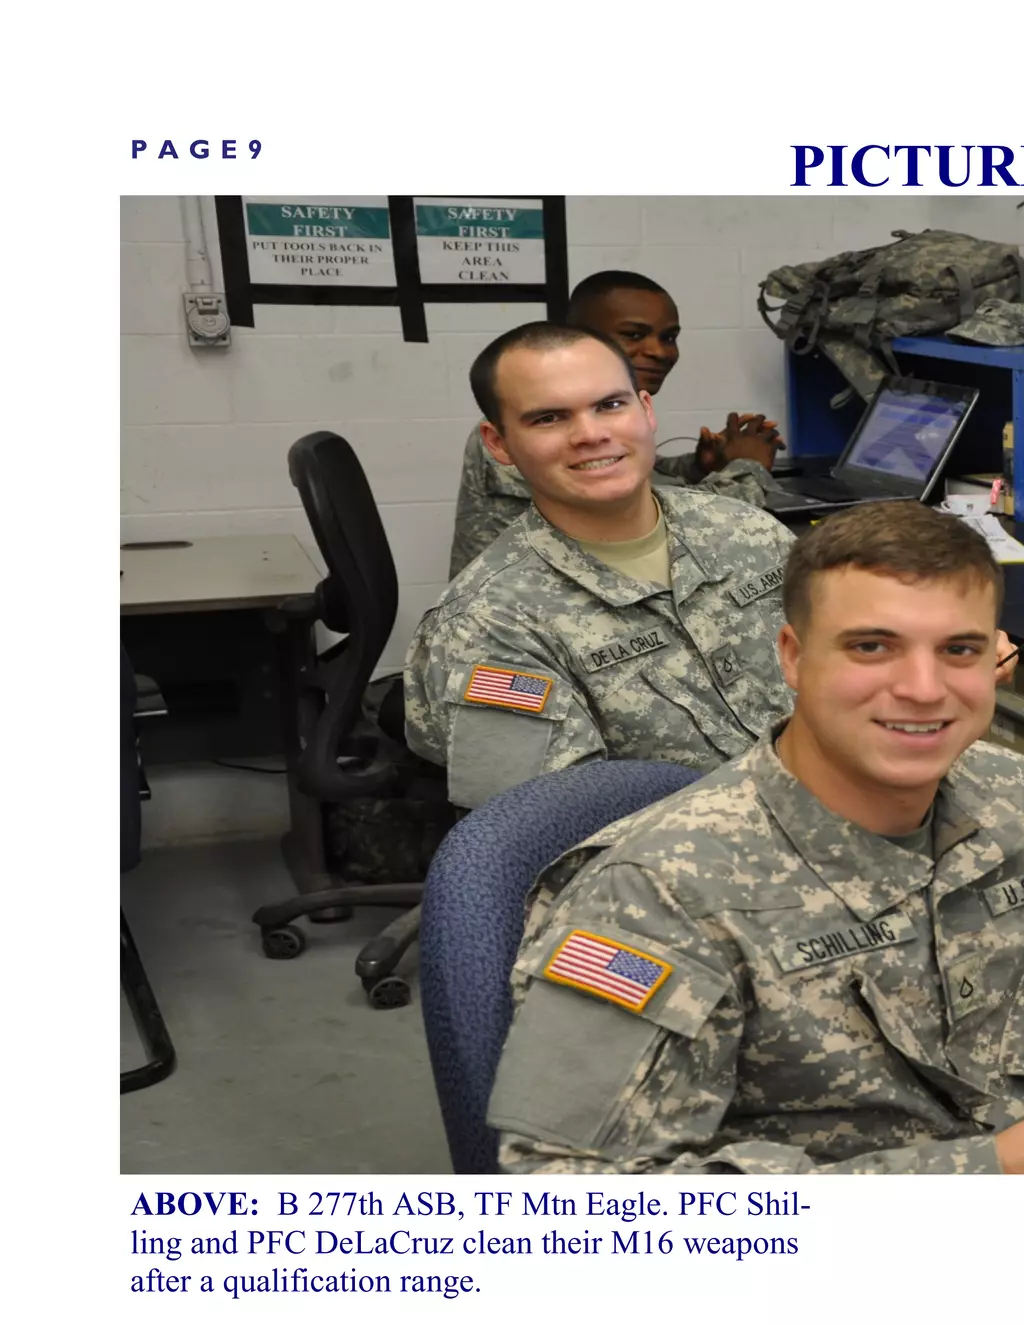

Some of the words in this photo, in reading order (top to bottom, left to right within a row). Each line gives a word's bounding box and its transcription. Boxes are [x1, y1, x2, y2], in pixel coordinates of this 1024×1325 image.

[281, 205, 356, 220] SAFETY
[447, 207, 517, 221] SAFETY
[293, 224, 348, 238] FIRST
[459, 225, 510, 238] FIRST
[252, 241, 278, 250] PUT
[280, 242, 326, 252] TOOLS
[329, 243, 366, 253] BACK
[369, 244, 383, 253] IN
[443, 241, 483, 252] KEEP
[486, 242, 520, 252] THIS
[272, 254, 314, 264] THEIR
[317, 255, 370, 265] PROPER
[461, 256, 503, 267] AREA
[300, 267, 343, 277] PLACE
[458, 270, 510, 281] CLEAN
[590, 649, 610, 667] DE
[609, 643, 630, 661] LA
[630, 631, 664, 653] CRUZ
[796, 921, 896, 963] SCHILLING
